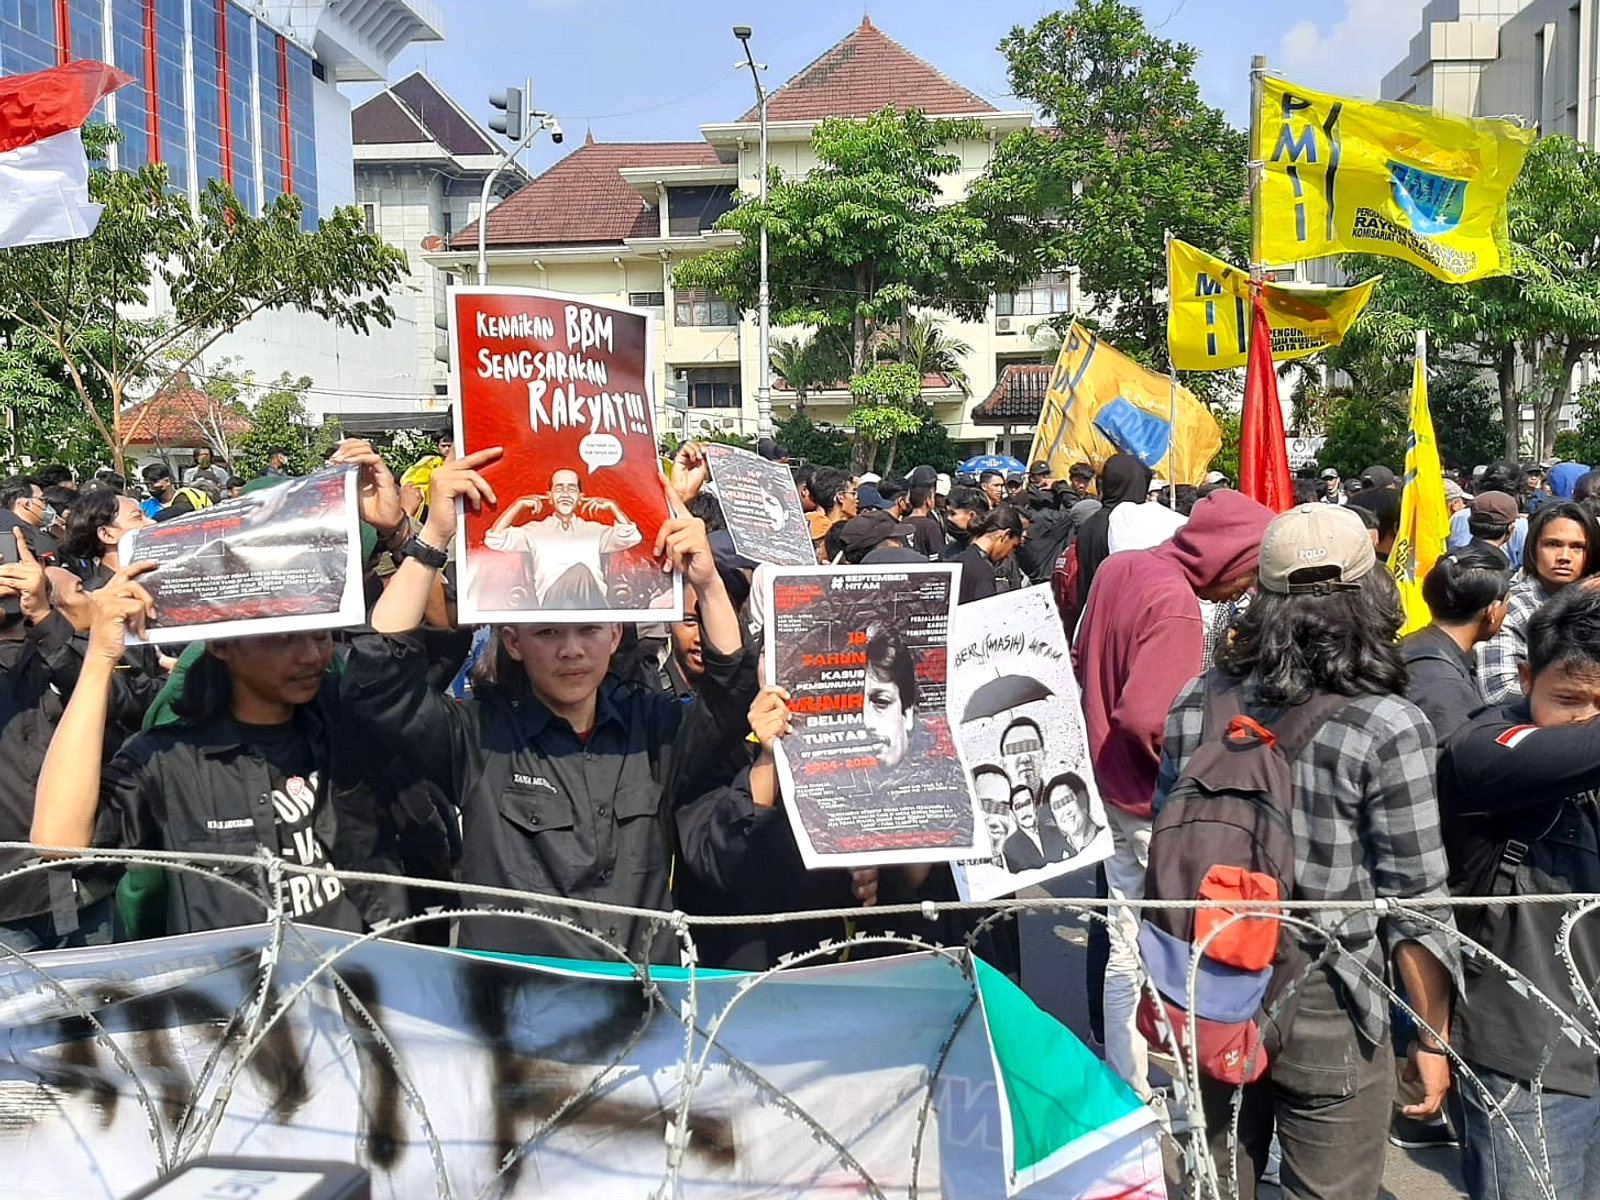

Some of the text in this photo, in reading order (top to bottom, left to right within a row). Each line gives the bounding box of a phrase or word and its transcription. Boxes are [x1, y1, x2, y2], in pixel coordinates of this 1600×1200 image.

[564, 305, 613, 354] BBM
[477, 348, 608, 388] SENGSARAKAN
[1299, 548, 1327, 559] POLO
[845, 574, 909, 582] SEPTEMBER
[845, 582, 880, 590] HITAM
[802, 652, 867, 668] TAHUN
[821, 669, 865, 680] KASUS
[796, 680, 865, 691] PEMBUNUHAN
[806, 713, 863, 727] BELUM
[802, 729, 868, 745] TUNTAS
